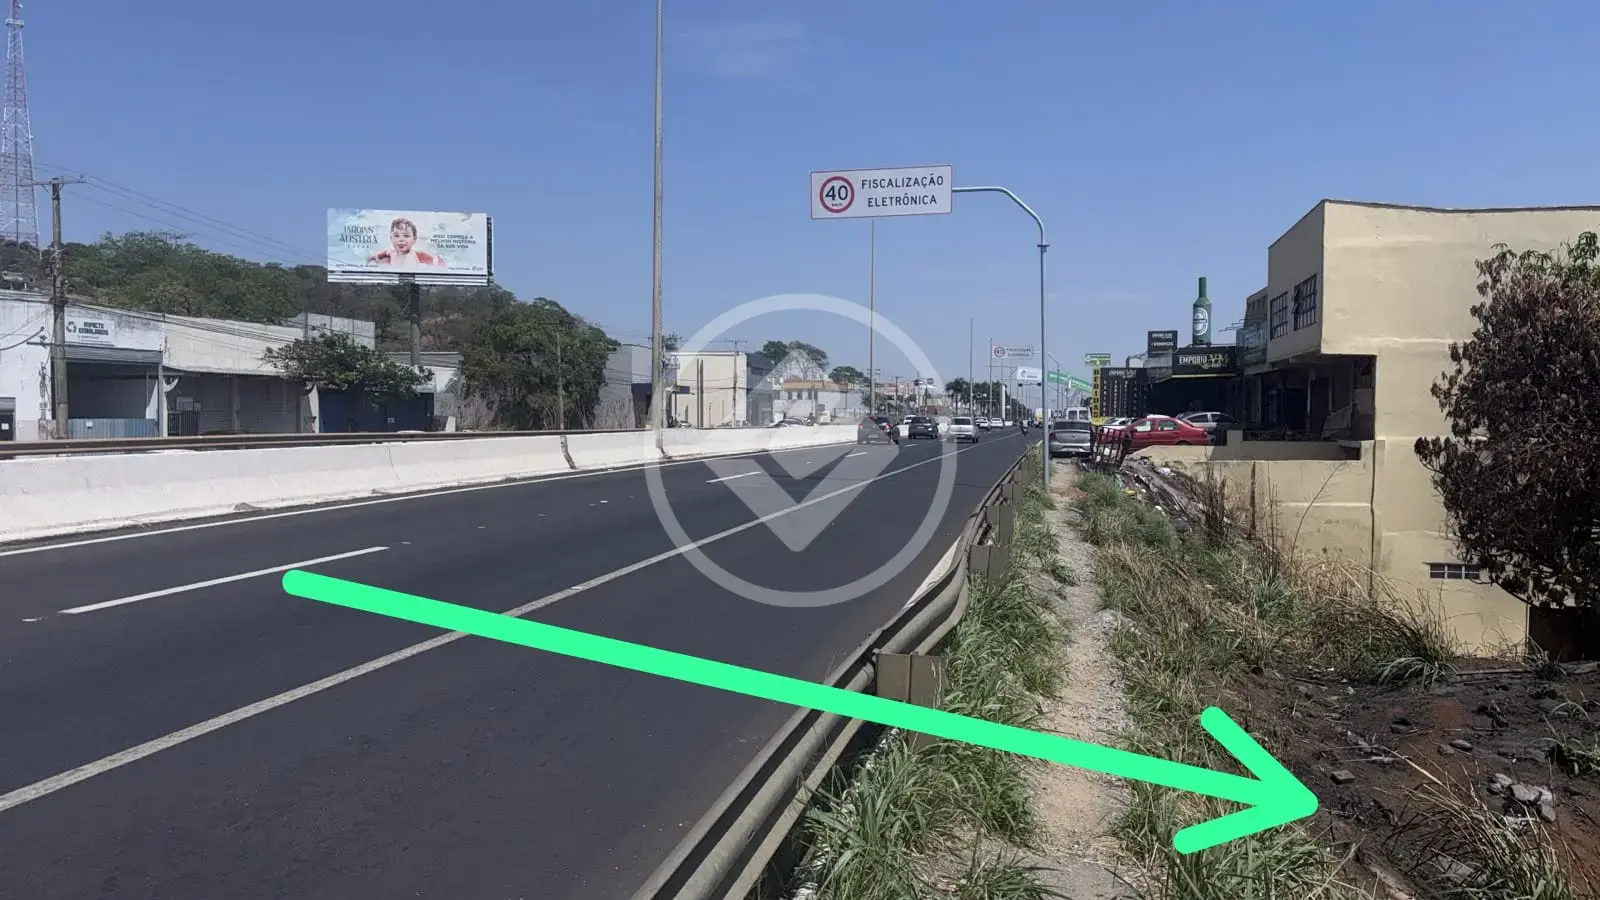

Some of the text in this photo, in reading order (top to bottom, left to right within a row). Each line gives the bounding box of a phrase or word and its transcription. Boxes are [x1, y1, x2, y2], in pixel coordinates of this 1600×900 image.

[861, 173, 944, 189] FISCALIZAÇÃO
[825, 185, 848, 201] 40
[867, 193, 937, 207] ELETRÔNICA
